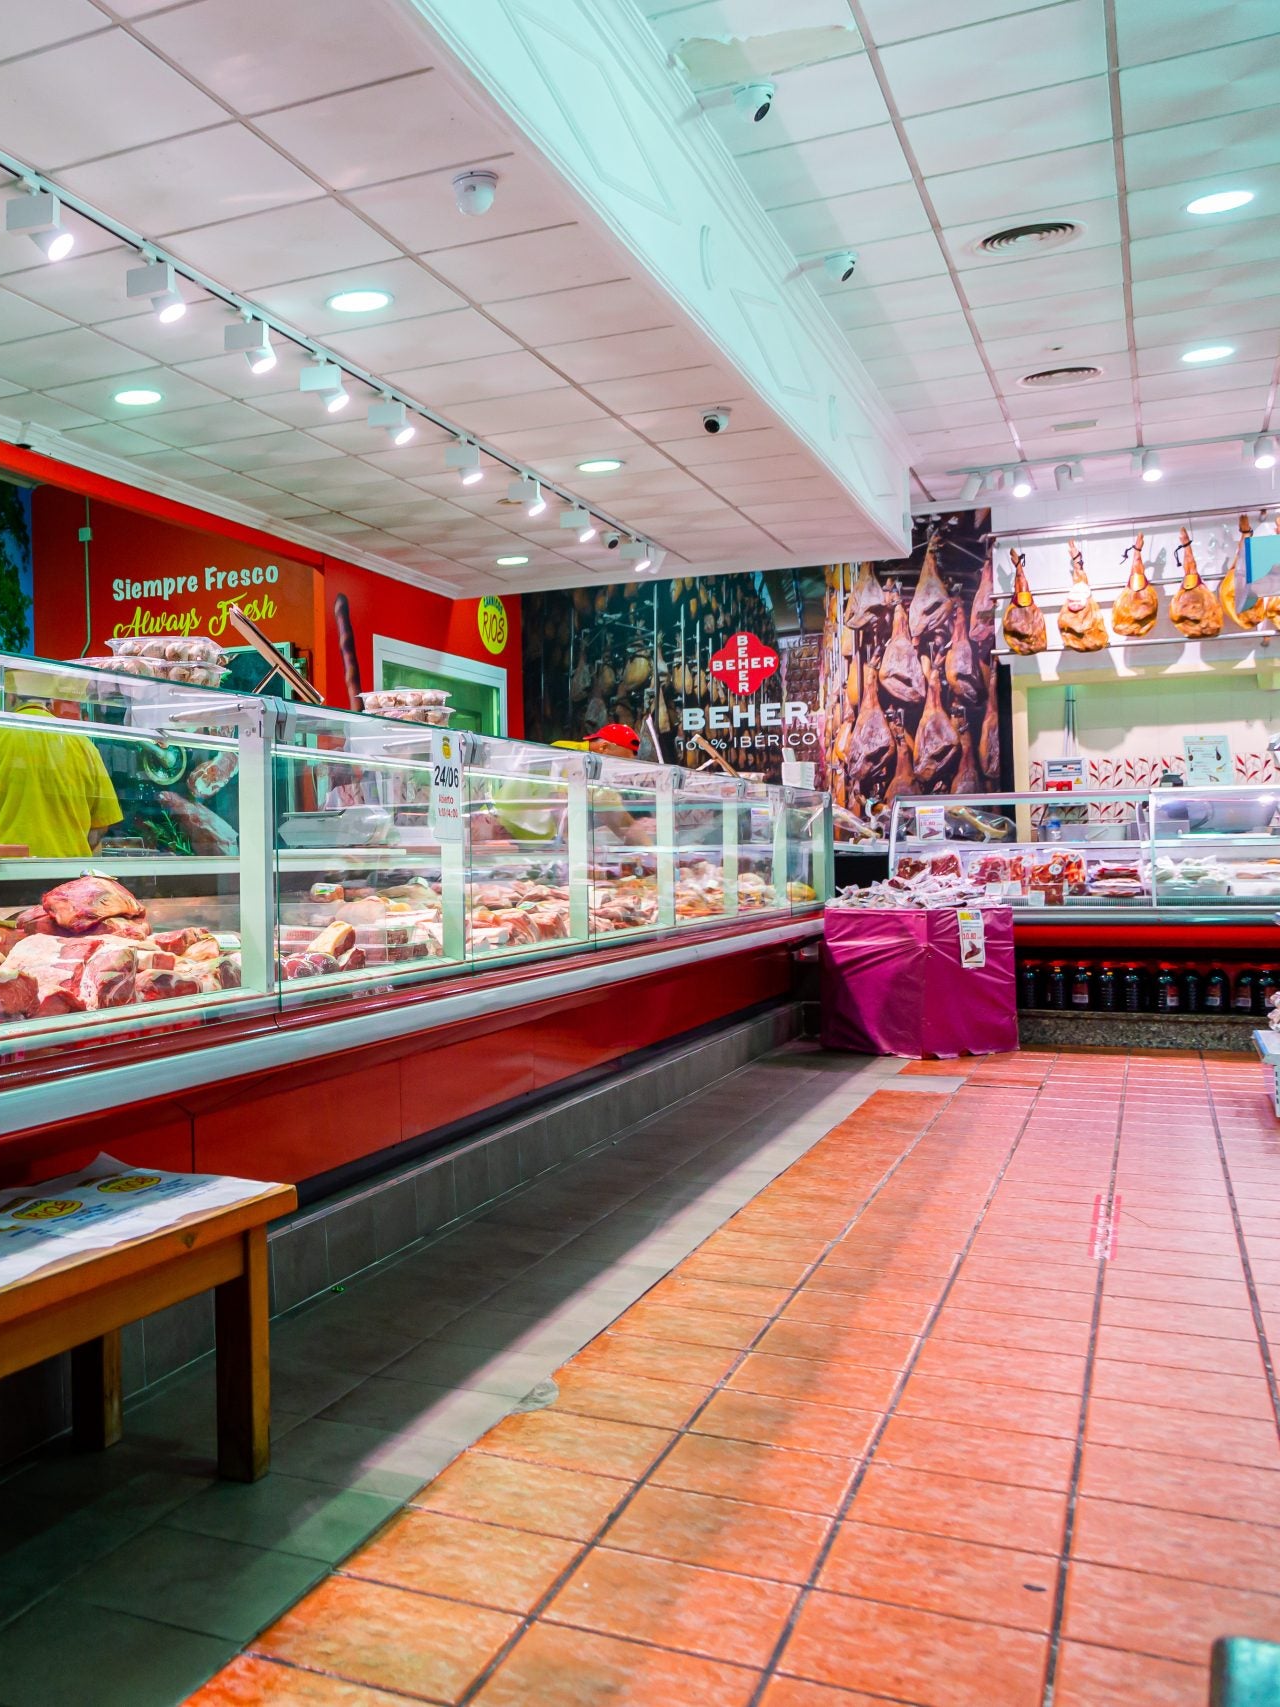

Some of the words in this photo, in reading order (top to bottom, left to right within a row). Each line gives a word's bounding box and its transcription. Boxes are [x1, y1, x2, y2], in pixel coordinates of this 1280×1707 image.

[113, 575, 199, 601] Siempre
[205, 565, 279, 591] Fresco
[113, 606, 202, 638] Always
[208, 592, 277, 636] Fesh
[482, 611, 505, 644] RIOS
[712, 656, 775, 672] BEHER
[737, 635, 750, 693] BEHER
[682, 701, 808, 731] BEHER
[734, 732, 817, 749] IBÉRICO
[434, 765, 459, 788] 24/06
[26, 1200, 78, 1219] RIOS
